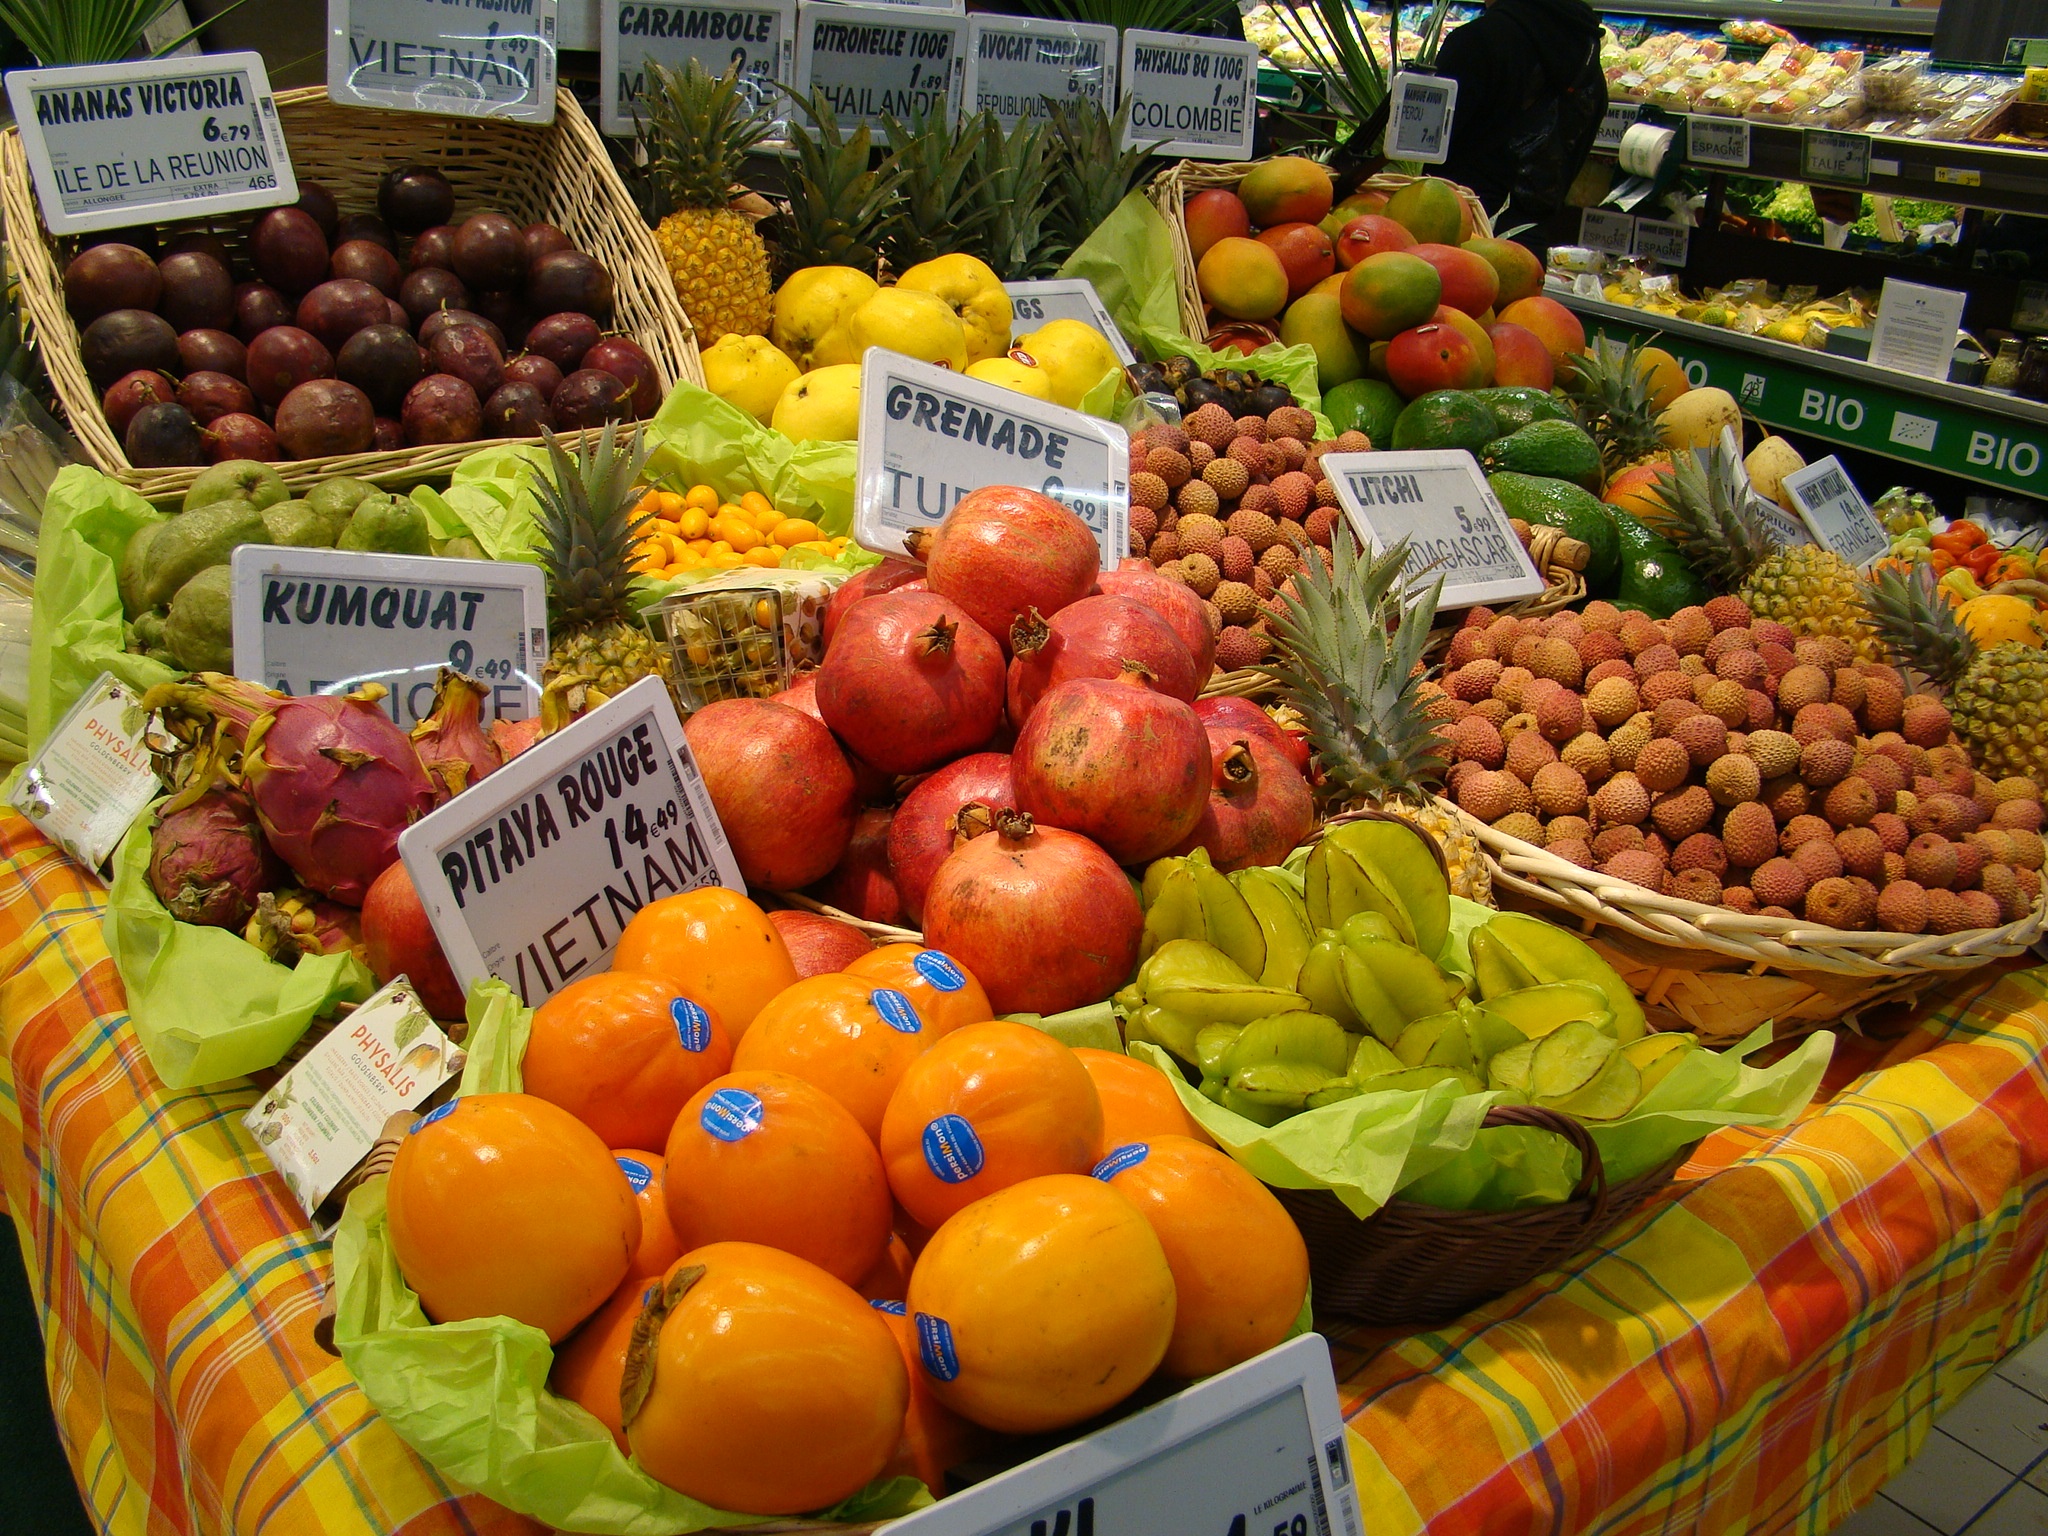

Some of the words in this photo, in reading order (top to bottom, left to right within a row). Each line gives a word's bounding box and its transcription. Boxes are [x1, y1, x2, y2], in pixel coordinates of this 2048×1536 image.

[619, 6, 772, 42] CARAMBOLE
[813, 24, 904, 57] CITRONELLE
[910, 31, 949, 60] 100G
[350, 37, 535, 89] VIETNAM
[979, 33, 1033, 62] AVOCAT
[1035, 39, 1100, 67] TROPICAL
[1134, 48, 1189, 76] PHYSALIS
[1193, 54, 1209, 79] BQ
[1213, 55, 1243, 81] 100G
[38, 87, 132, 126] ANANAS
[139, 76, 244, 115] VICTORIA
[976, 94, 1047, 118] REPUBLIQUE
[1132, 101, 1243, 133] COLOMBIE
[1401, 105, 1424, 121] PEROU
[1622, 110, 1636, 120] BIO
[1692, 141, 1743, 156] ESPAGNE
[54, 165, 92, 194] ILE
[97, 161, 128, 189] DE
[134, 158, 165, 184] LA
[168, 145, 269, 180] REUNION
[193, 182, 219, 191] EXTRA
[249, 174, 277, 190] 465
[1583, 232, 1626, 248] ESPAGNE
[1638, 240, 1682, 258] ESPAGNE
[886, 384, 1069, 470] GRENADE
[1800, 388, 1864, 431] BIO
[1966, 431, 2040, 477] BIO
[883, 466, 972, 519] TU
[1349, 474, 1423, 506] LITCHI
[1402, 534, 1516, 574] ADAGASCAR
[1829, 518, 1876, 557] FRANCE
[263, 581, 485, 631] KUMQUAT
[84, 718, 152, 778] PHYSALIS
[89, 741, 132, 776] GOLDENBERRY
[442, 794, 561, 909] PITAYA
[558, 723, 658, 828] ROUGE
[491, 821, 710, 1008] VIETNAM
[350, 1024, 416, 1098] PHYSALIS
[351, 1053, 389, 1096] GOLDENBERRY
[1253, 1505, 1263, 1516] LE
[1264, 1480, 1308, 1511] KILOGRAMME
